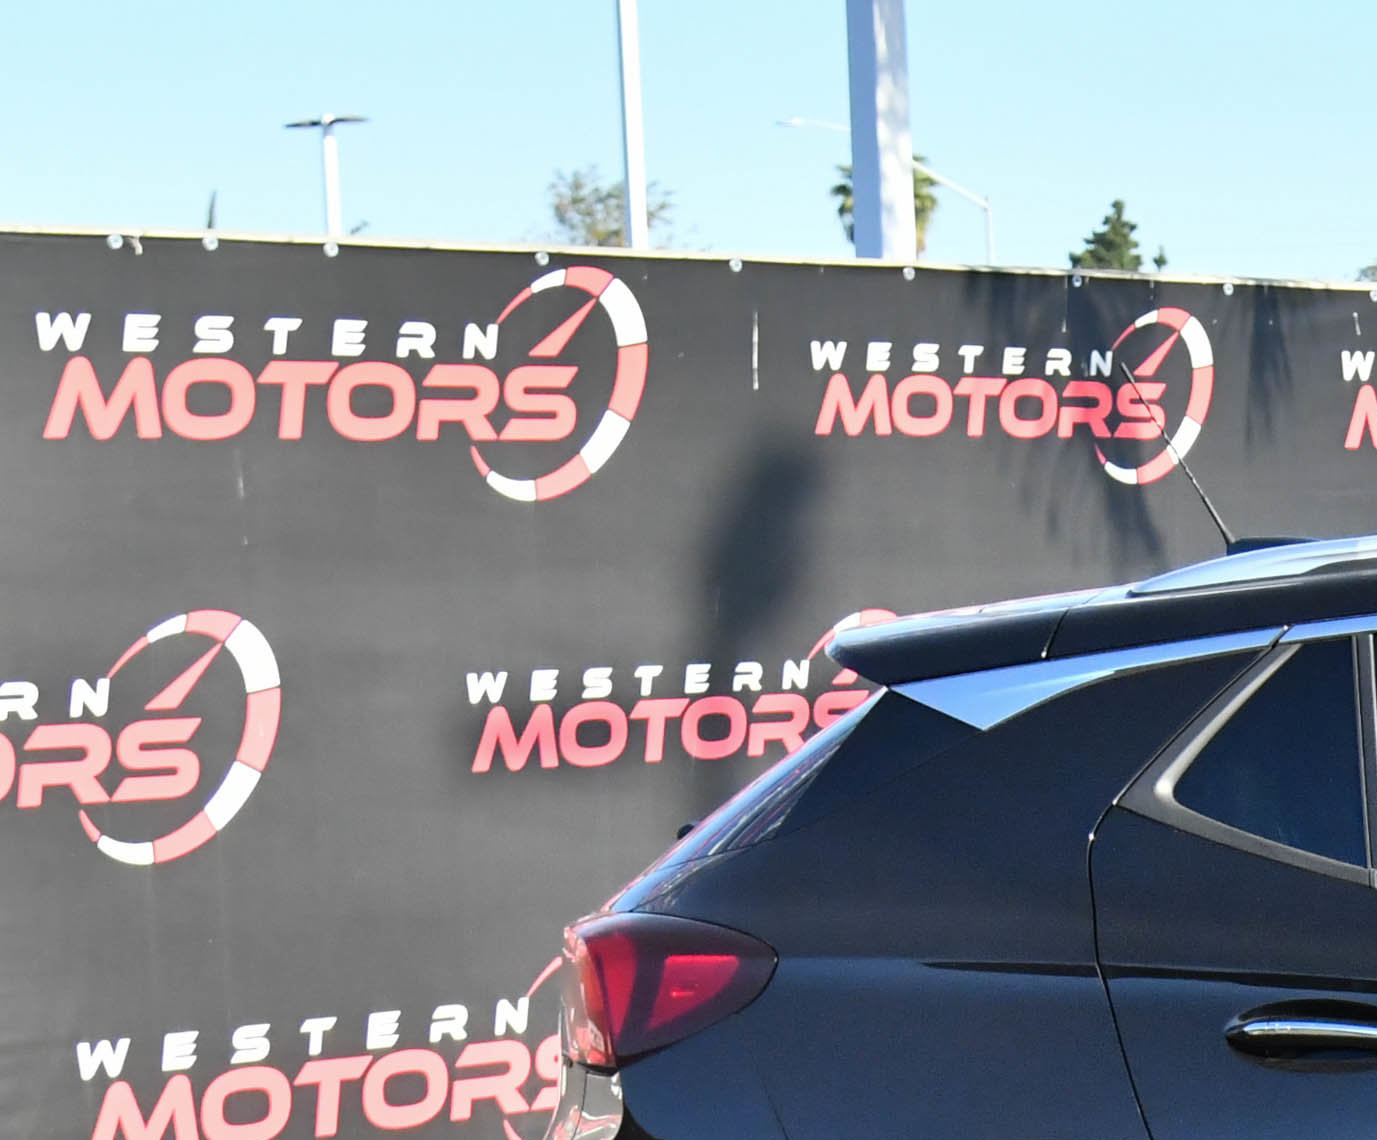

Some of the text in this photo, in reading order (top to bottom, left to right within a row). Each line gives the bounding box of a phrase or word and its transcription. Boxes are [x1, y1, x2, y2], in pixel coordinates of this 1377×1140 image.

[36, 311, 499, 360] WESTERN
[811, 340, 1114, 377] WESTERN
[43, 356, 579, 442] MOTORS
[814, 373, 1168, 441] MOTORS
[466, 660, 810, 705] WESTERN
[0, 716, 202, 809] RS
[76, 997, 530, 1082] WESTERN
